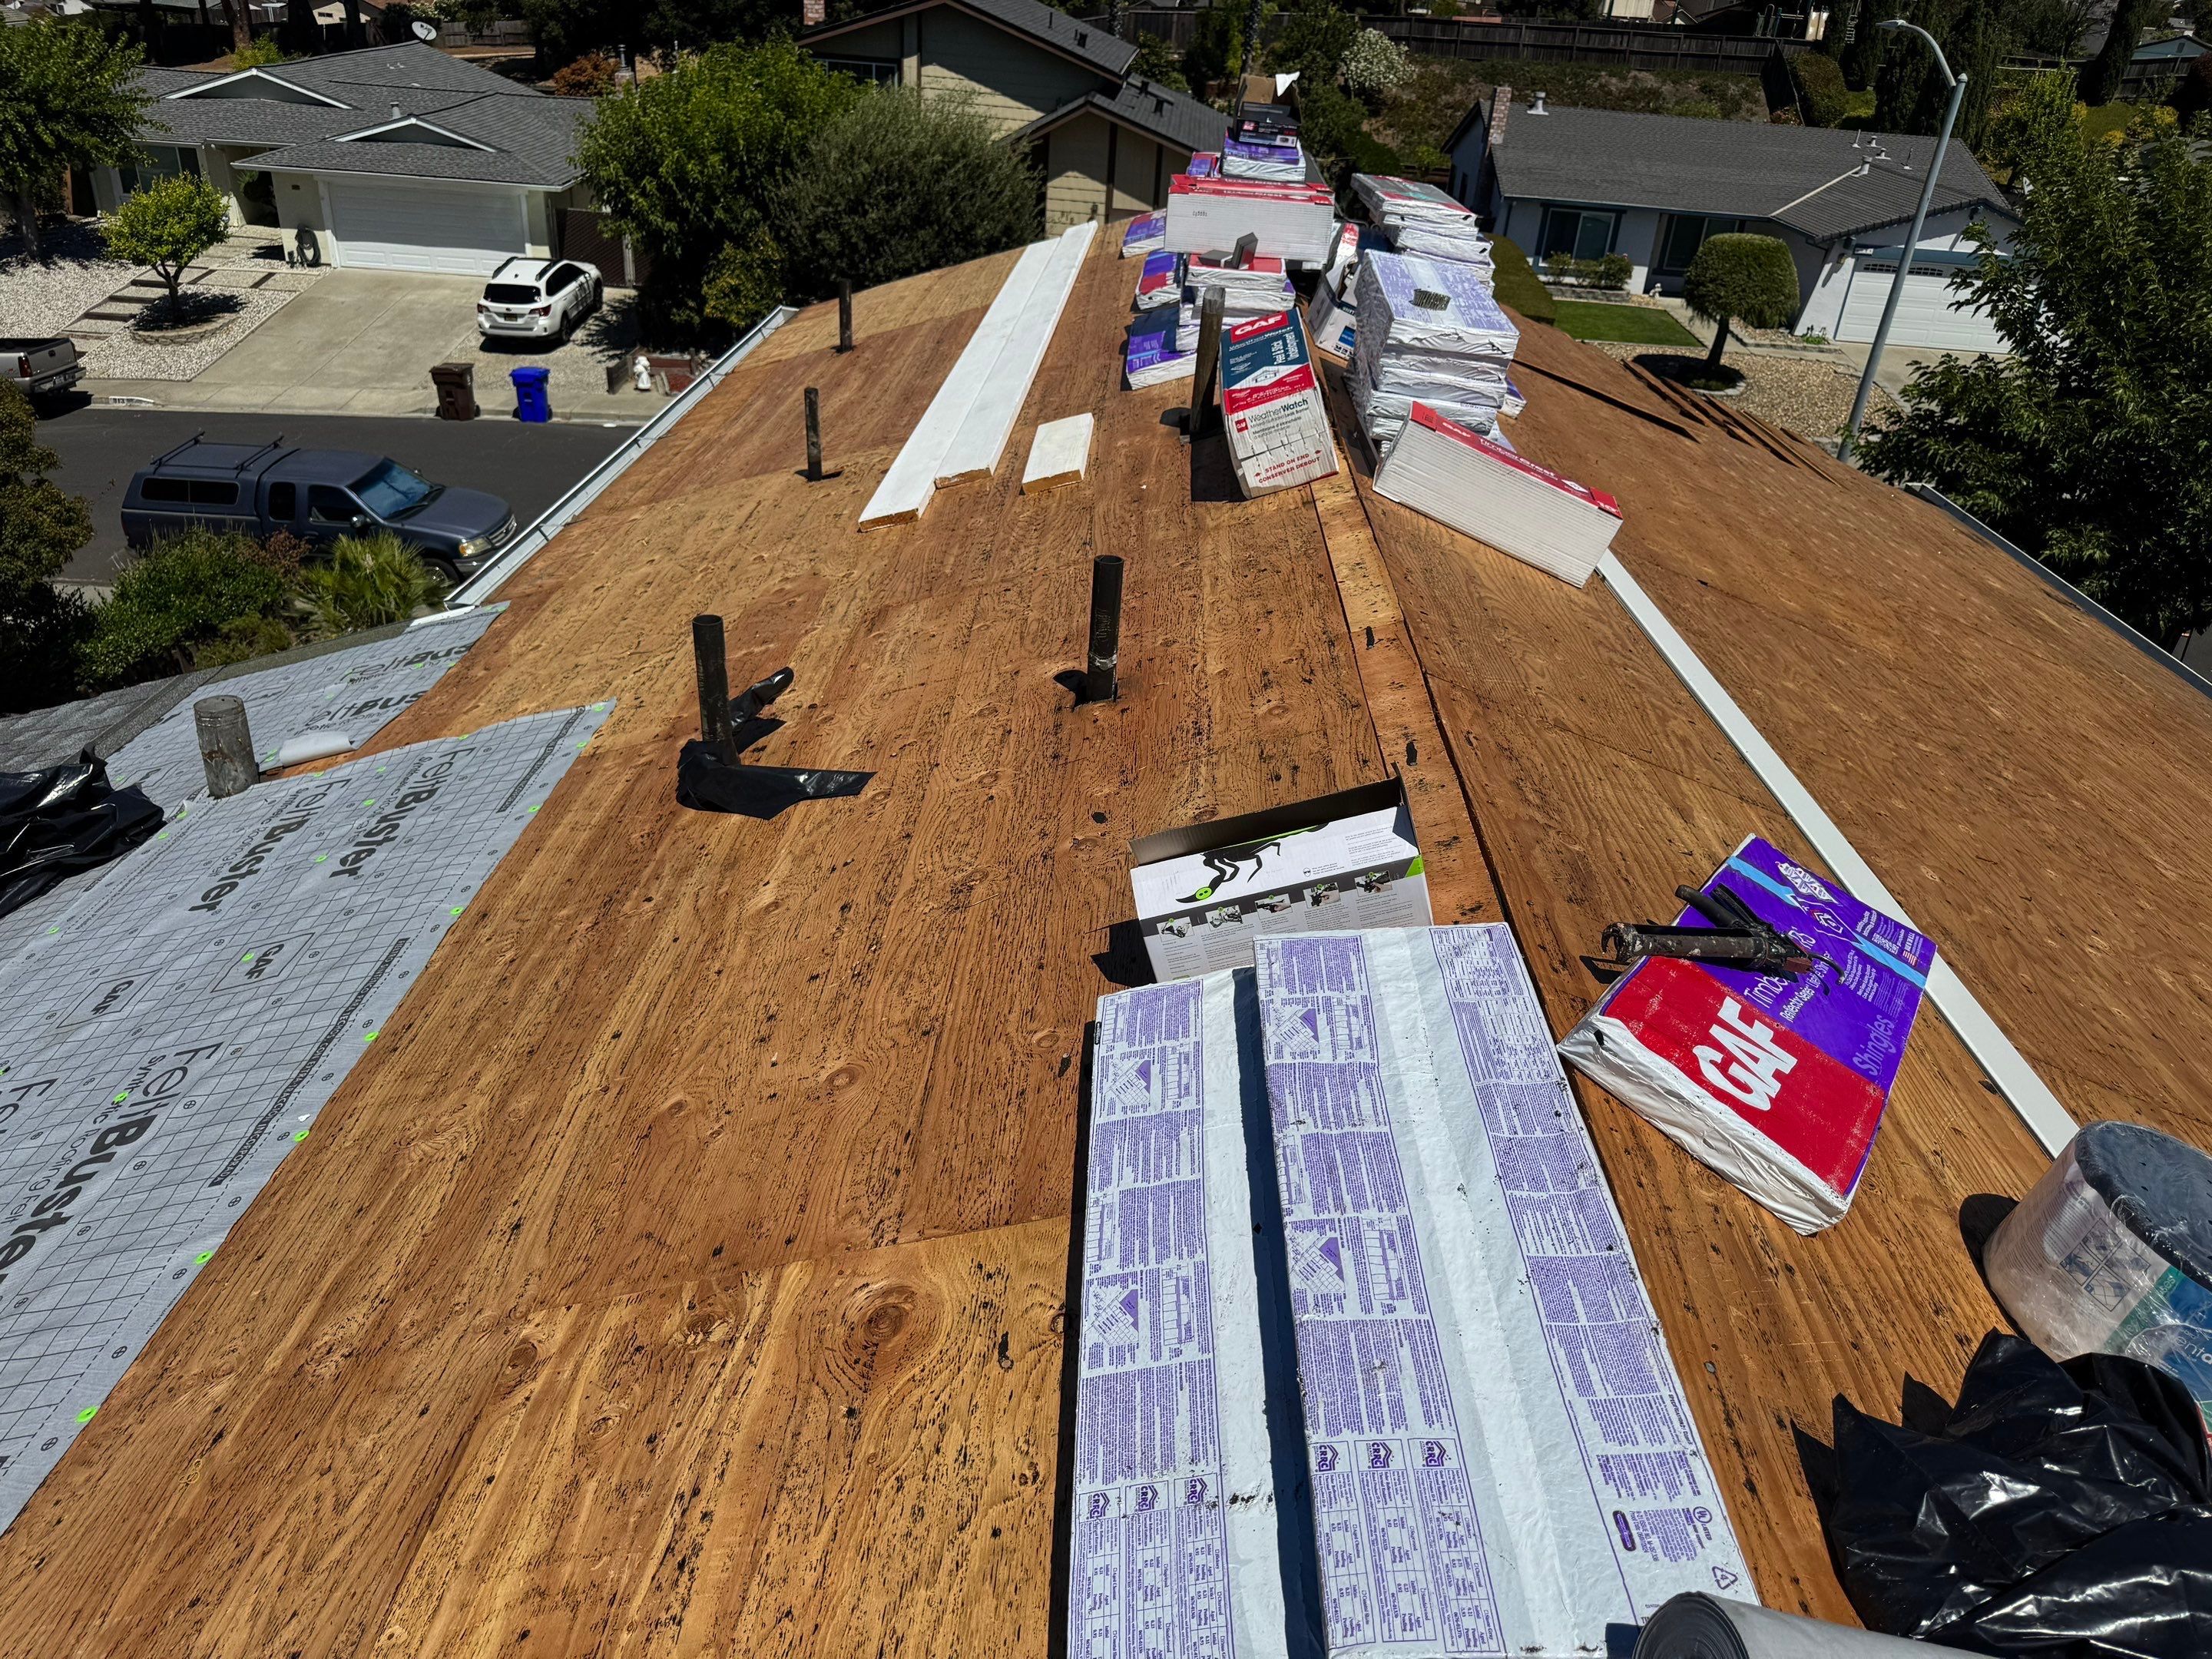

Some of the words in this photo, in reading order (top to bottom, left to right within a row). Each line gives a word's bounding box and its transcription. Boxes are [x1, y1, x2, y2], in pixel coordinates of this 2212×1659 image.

[1235, 315, 1282, 336] GAF
[1248, 399, 1308, 423] WeatherWatch
[1259, 467, 1294, 484] CONSERVER
[1296, 456, 1320, 470] DEBOUT
[1265, 463, 1285, 473] STAND
[1297, 453, 1310, 462] END
[329, 747, 475, 879] FeltBuster
[188, 779, 353, 912] FeltBuster
[244, 944, 284, 979] GAF
[91, 979, 134, 1016] GAF
[1694, 997, 1797, 1111] GAF
[1853, 1015, 1896, 1075] Shingles
[0, 1041, 224, 1289] FeltBuste
[28, 1128, 102, 1192] Roofing
[1320, 1445, 1329, 1469] CRRC
[1372, 1442, 1382, 1465] CRRC
[1426, 1441, 1437, 1464] CRRC
[1701, 1524, 1712, 1541] LISTED
